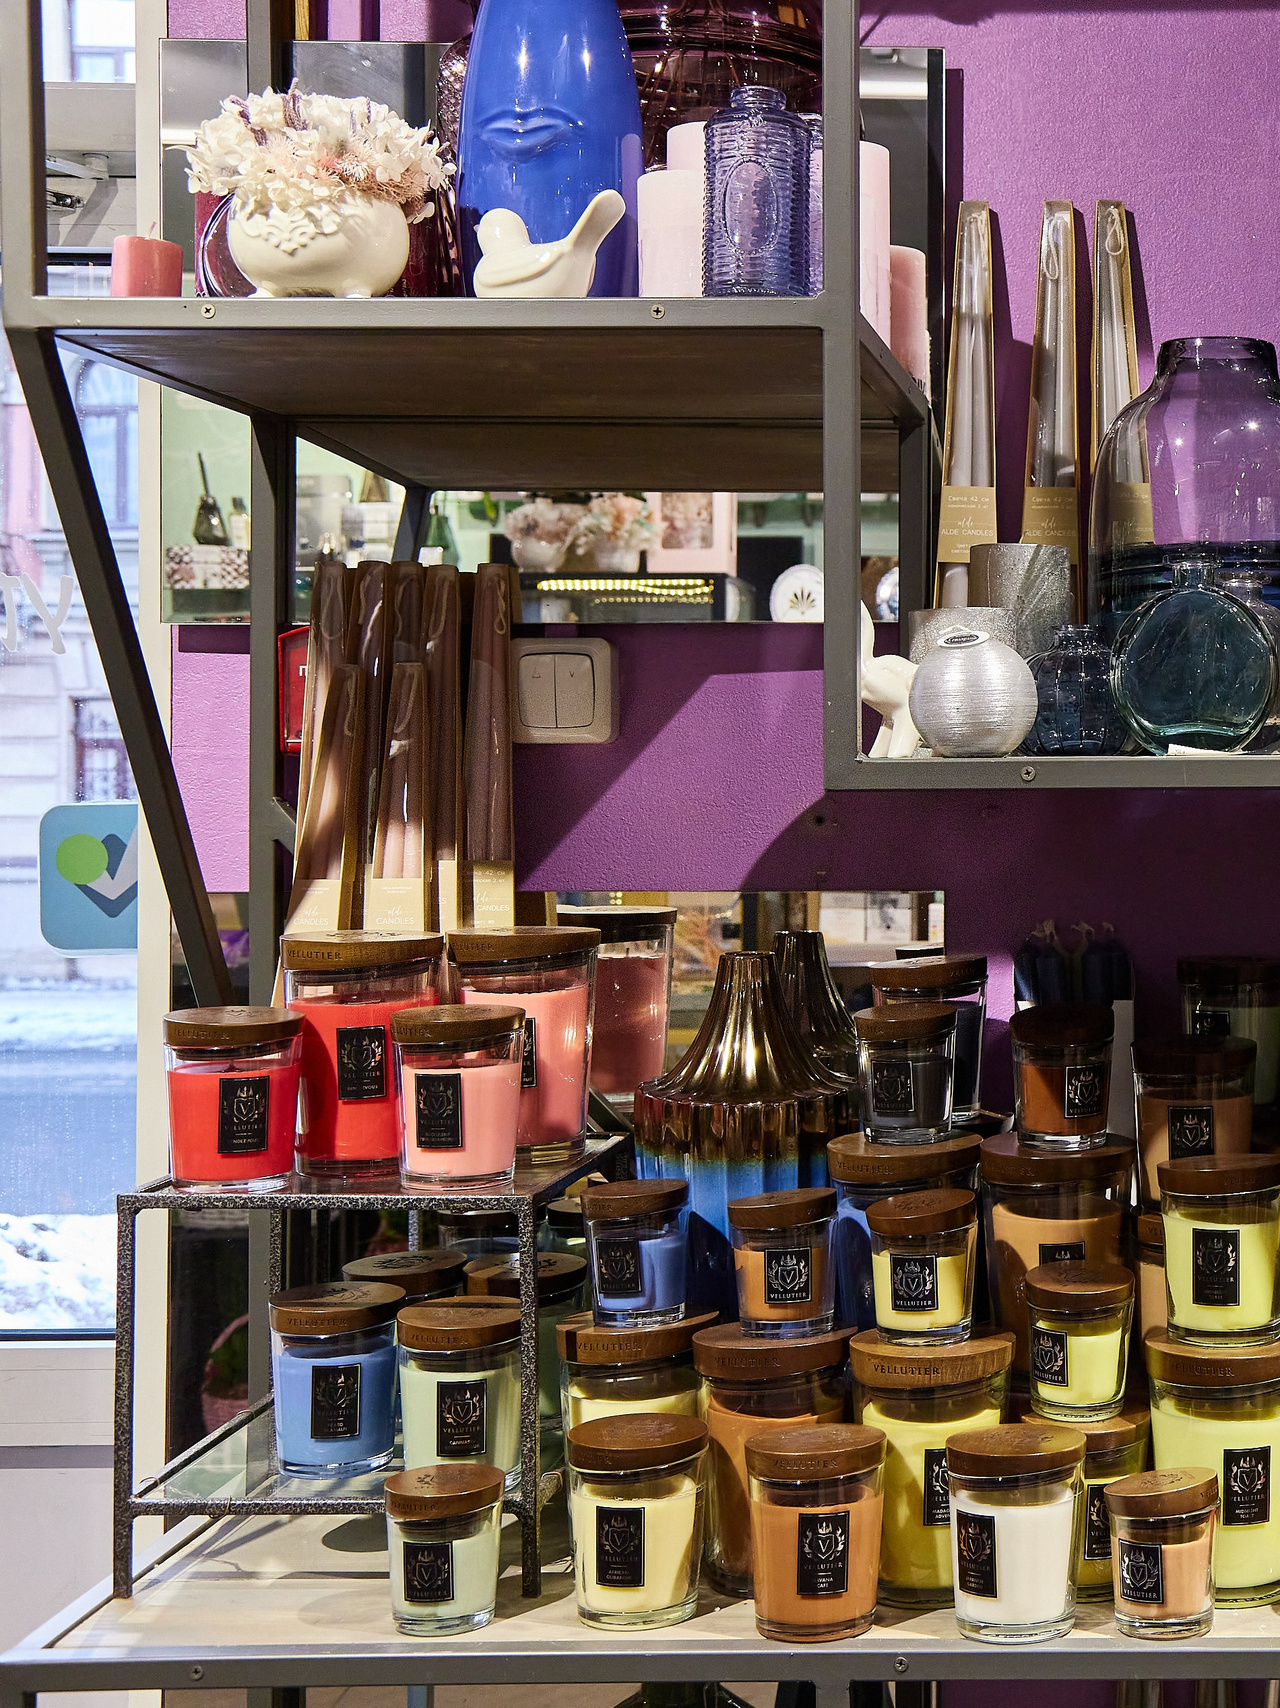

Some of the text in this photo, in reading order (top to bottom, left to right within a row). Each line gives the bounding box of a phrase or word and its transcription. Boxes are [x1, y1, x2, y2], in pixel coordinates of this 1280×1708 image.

[957, 517, 973, 528] alde
[476, 904, 510, 912] CANDLES
[293, 917, 329, 925] CANDLES
[376, 917, 415, 925] CANDLES
[287, 950, 342, 960] VELLUTIER
[344, 1070, 381, 1078] VELTIER
[224, 1123, 262, 1131] VLLUTIER
[287, 1317, 348, 1327] VELLUTIER
[411, 1334, 469, 1345] VELLUTIER
[577, 1342, 642, 1352] VELLUTIER
[714, 1356, 781, 1367] VELLUTIER
[874, 1364, 941, 1375] VELLUTIER
[1033, 1369, 1063, 1381] VELLUTIER
[443, 1426, 480, 1434] VELLUTIER
[772, 1459, 838, 1470] VELLUTIER
[804, 1562, 844, 1570] VELUTIER
[1123, 1587, 1158, 1598] VELLUTIER
